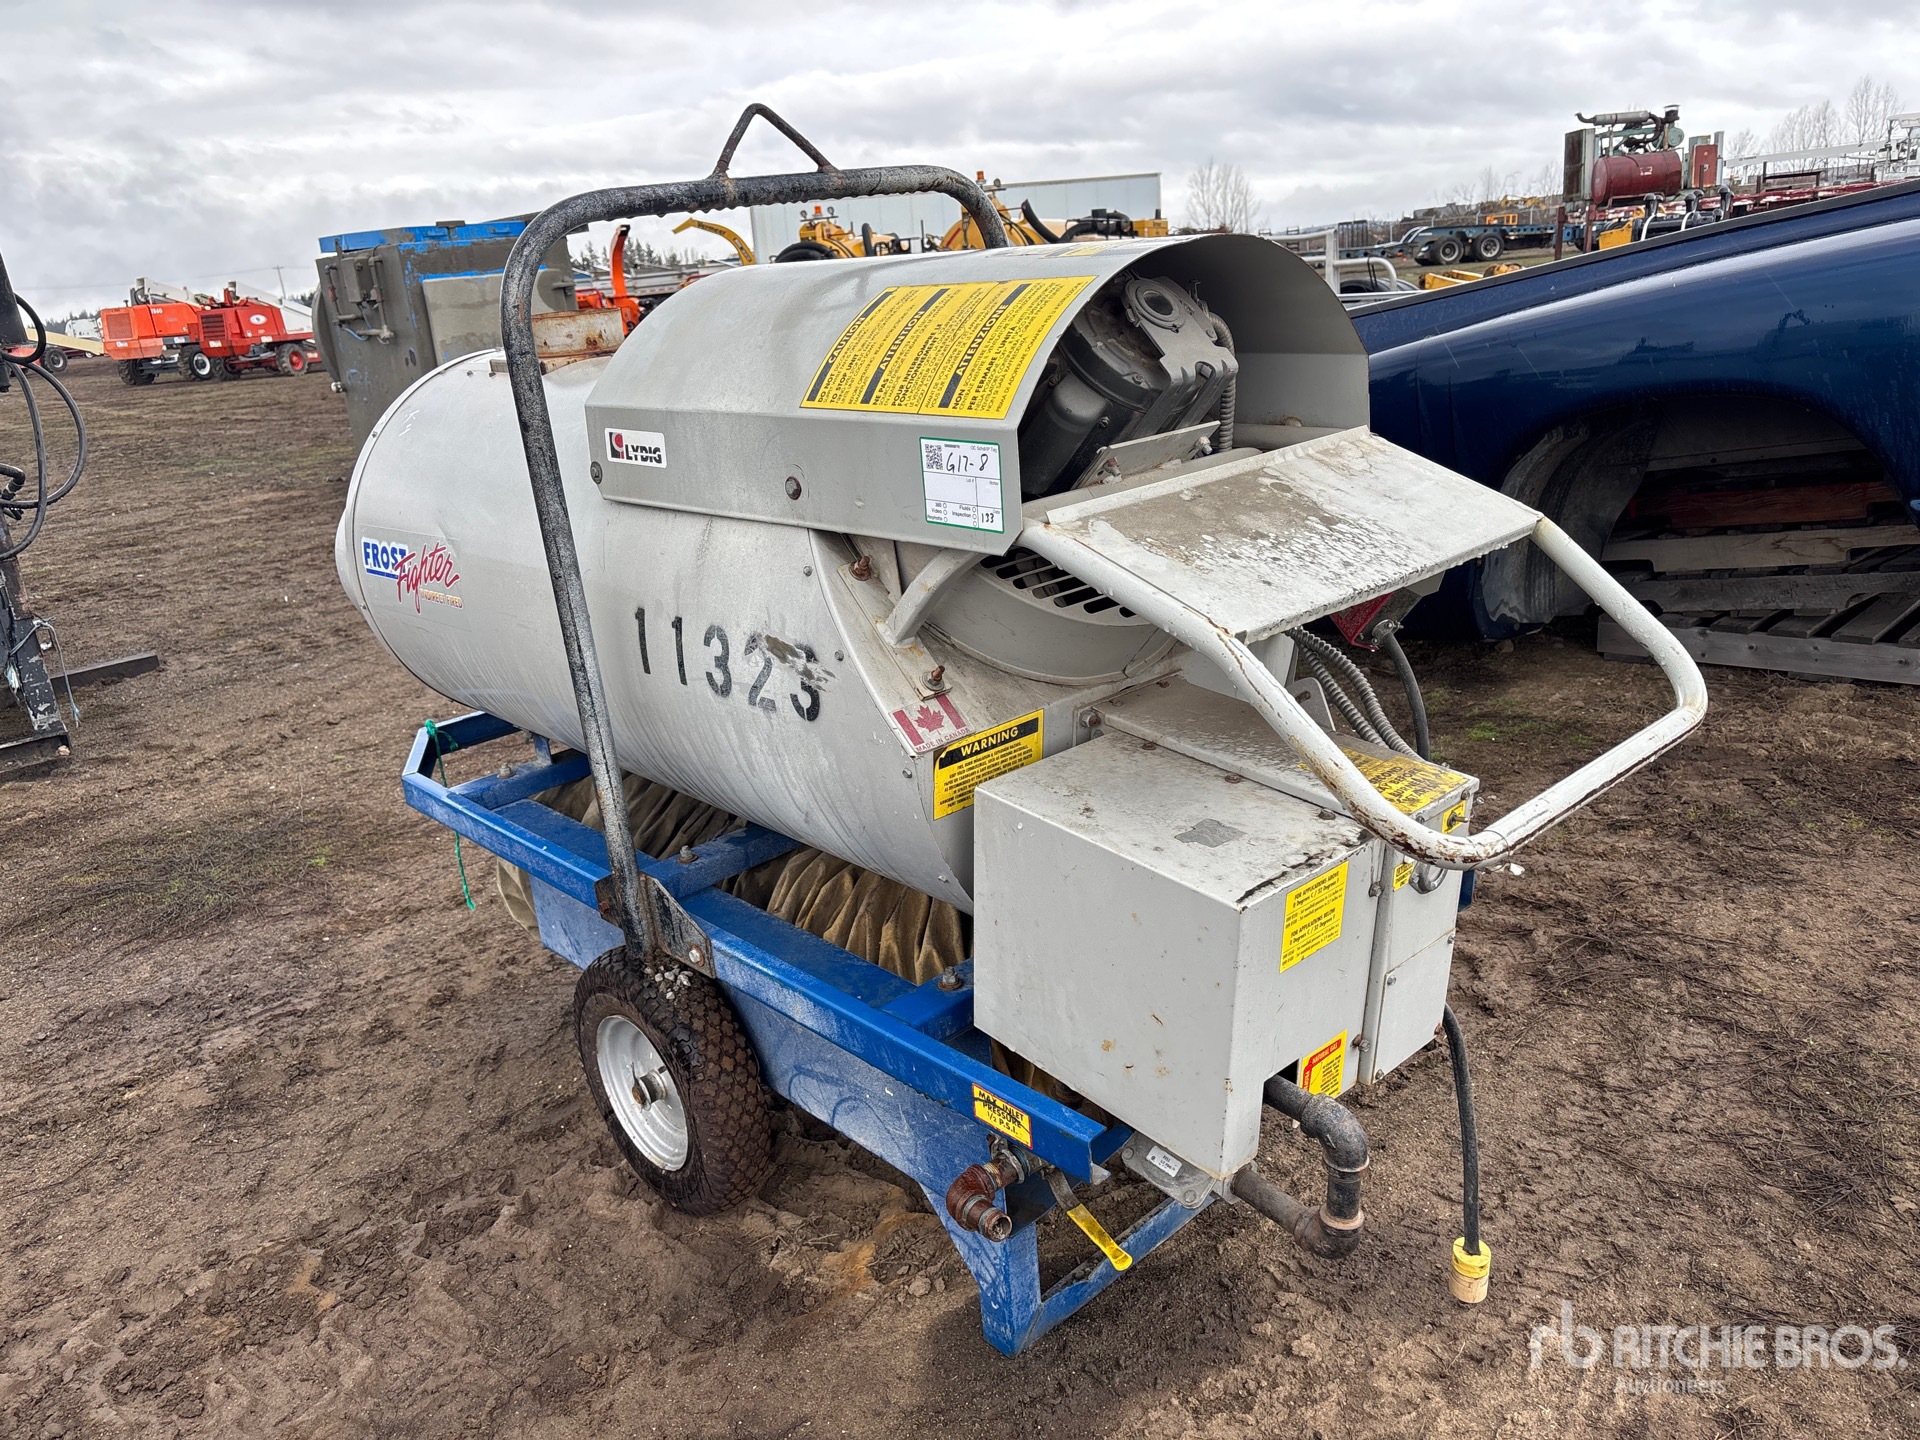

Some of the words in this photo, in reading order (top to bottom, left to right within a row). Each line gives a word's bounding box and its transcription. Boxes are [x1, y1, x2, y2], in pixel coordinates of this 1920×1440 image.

[826, 317, 866, 363] CAUTION
[877, 310, 925, 370] ATTENTION
[953, 303, 1009, 376] ATTENZIONE
[828, 392, 838, 403] TO
[834, 372, 849, 391] STOP
[845, 353, 860, 370] UNIT
[890, 384, 906, 406] POUR
[901, 331, 937, 382] INTERROMPRE
[896, 336, 939, 406] FONCTIONNEMENT
[966, 395, 978, 410] PER
[973, 356, 998, 393] FERMARE
[816, 390, 827, 402] DO
[823, 373, 836, 389] NOT
[871, 394, 881, 405] NE
[877, 378, 889, 392] PAS
[951, 388, 966, 409] NON
[625, 444, 662, 464] LYDIG
[363, 541, 406, 573] FROST
[393, 541, 460, 614] Fighter
[635, 607, 821, 722] 11323
[915, 740, 935, 752] MADE
[943, 726, 971, 741] CANADA
[960, 725, 1018, 757] WARNING
[1294, 891, 1302, 900] FOR
[1302, 877, 1326, 896] APPLICATIONS
[1327, 870, 1339, 882] ABOVE
[1290, 928, 1298, 938] FOR
[1298, 913, 1323, 933] APPLICATIONS
[983, 1102, 1021, 1129] PRESSURE
[987, 1111, 996, 1122] 1/2
[999, 1118, 1018, 1135] P.S.I.
[1003, 1104, 1024, 1121] INLET
